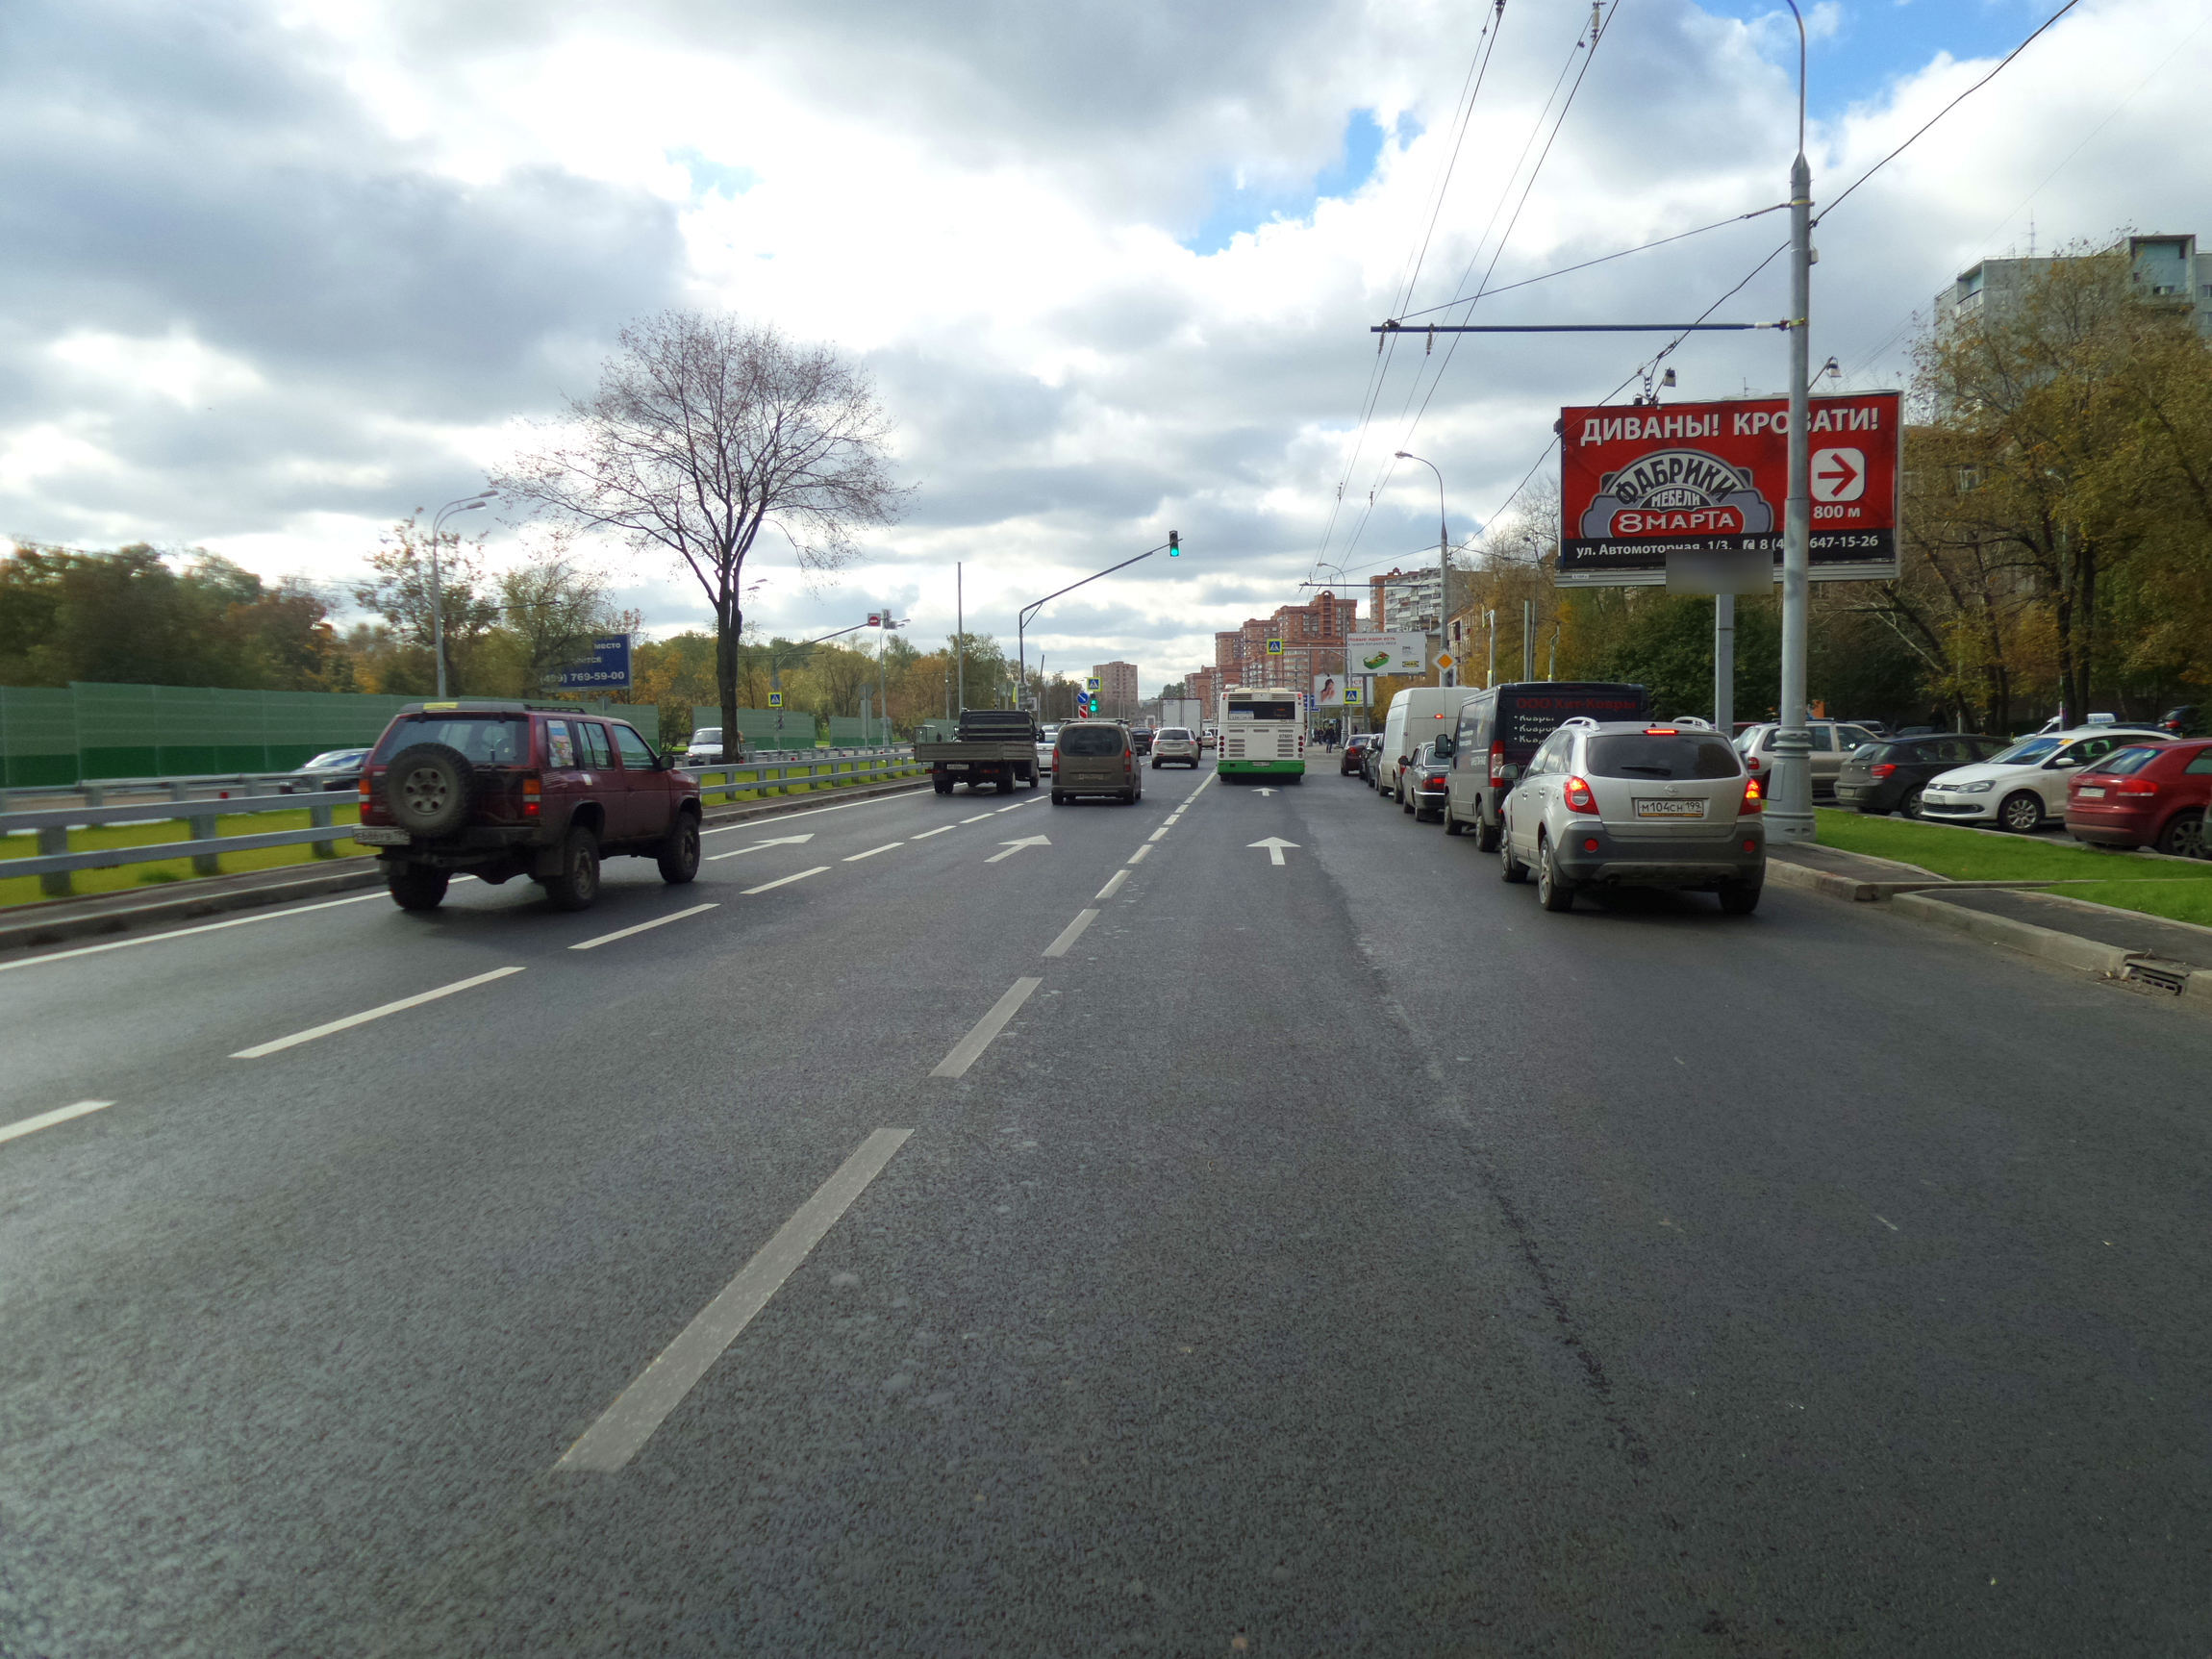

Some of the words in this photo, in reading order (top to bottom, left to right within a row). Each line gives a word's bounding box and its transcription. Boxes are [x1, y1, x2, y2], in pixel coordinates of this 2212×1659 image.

[1580, 414, 1720, 446] ДИВАНЫ!
[1616, 458, 1738, 505] ФАБРИКИ
[1650, 489, 1700, 507] МЕБЕЛИ
[1813, 505, 1844, 518] 800
[1809, 536, 1878, 548] 647-15-26
[1576, 547, 1596, 559] ул.
[570, 671, 625, 682] 769-59-00
